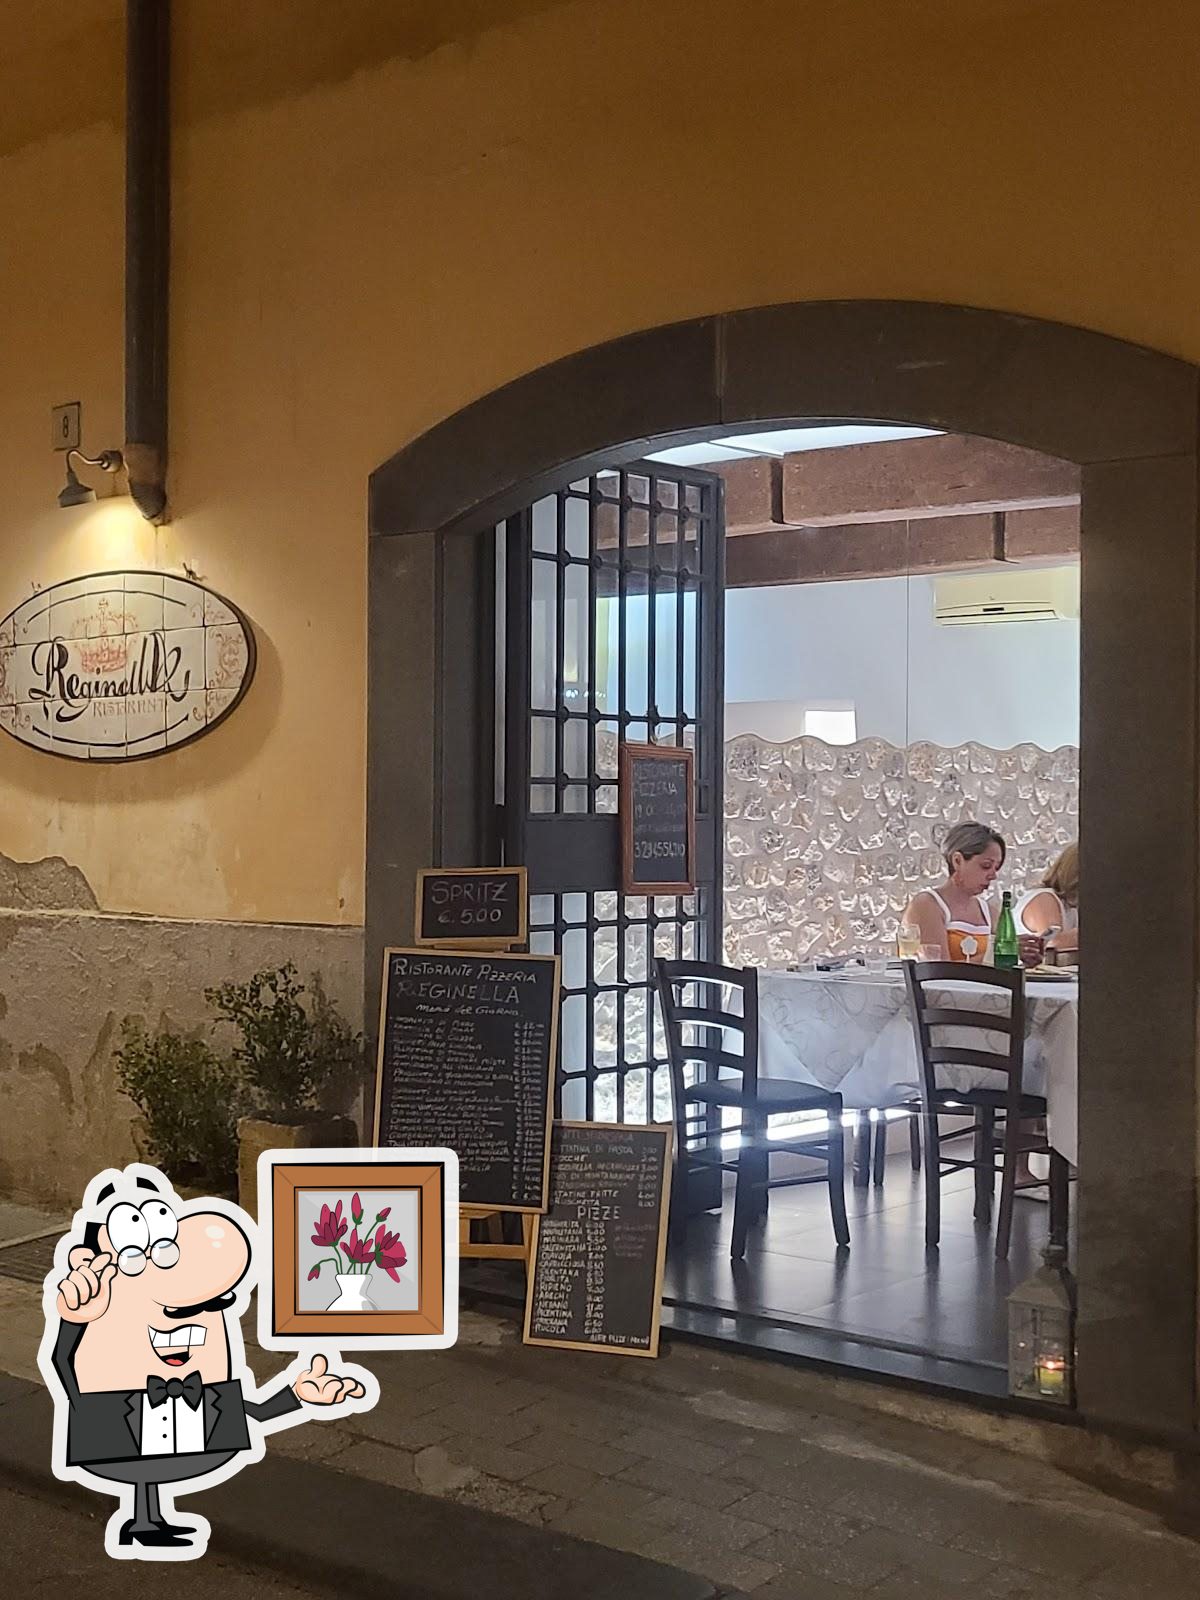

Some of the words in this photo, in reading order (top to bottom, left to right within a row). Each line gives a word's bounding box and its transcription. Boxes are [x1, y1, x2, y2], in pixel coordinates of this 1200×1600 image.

[62, 415, 69, 438] 8
[431, 881, 508, 905] SPRITZ
[476, 963, 537, 984] PIZZERIA
[396, 980, 521, 1004] REGINELLA
[577, 1204, 621, 1220] PIZZE
